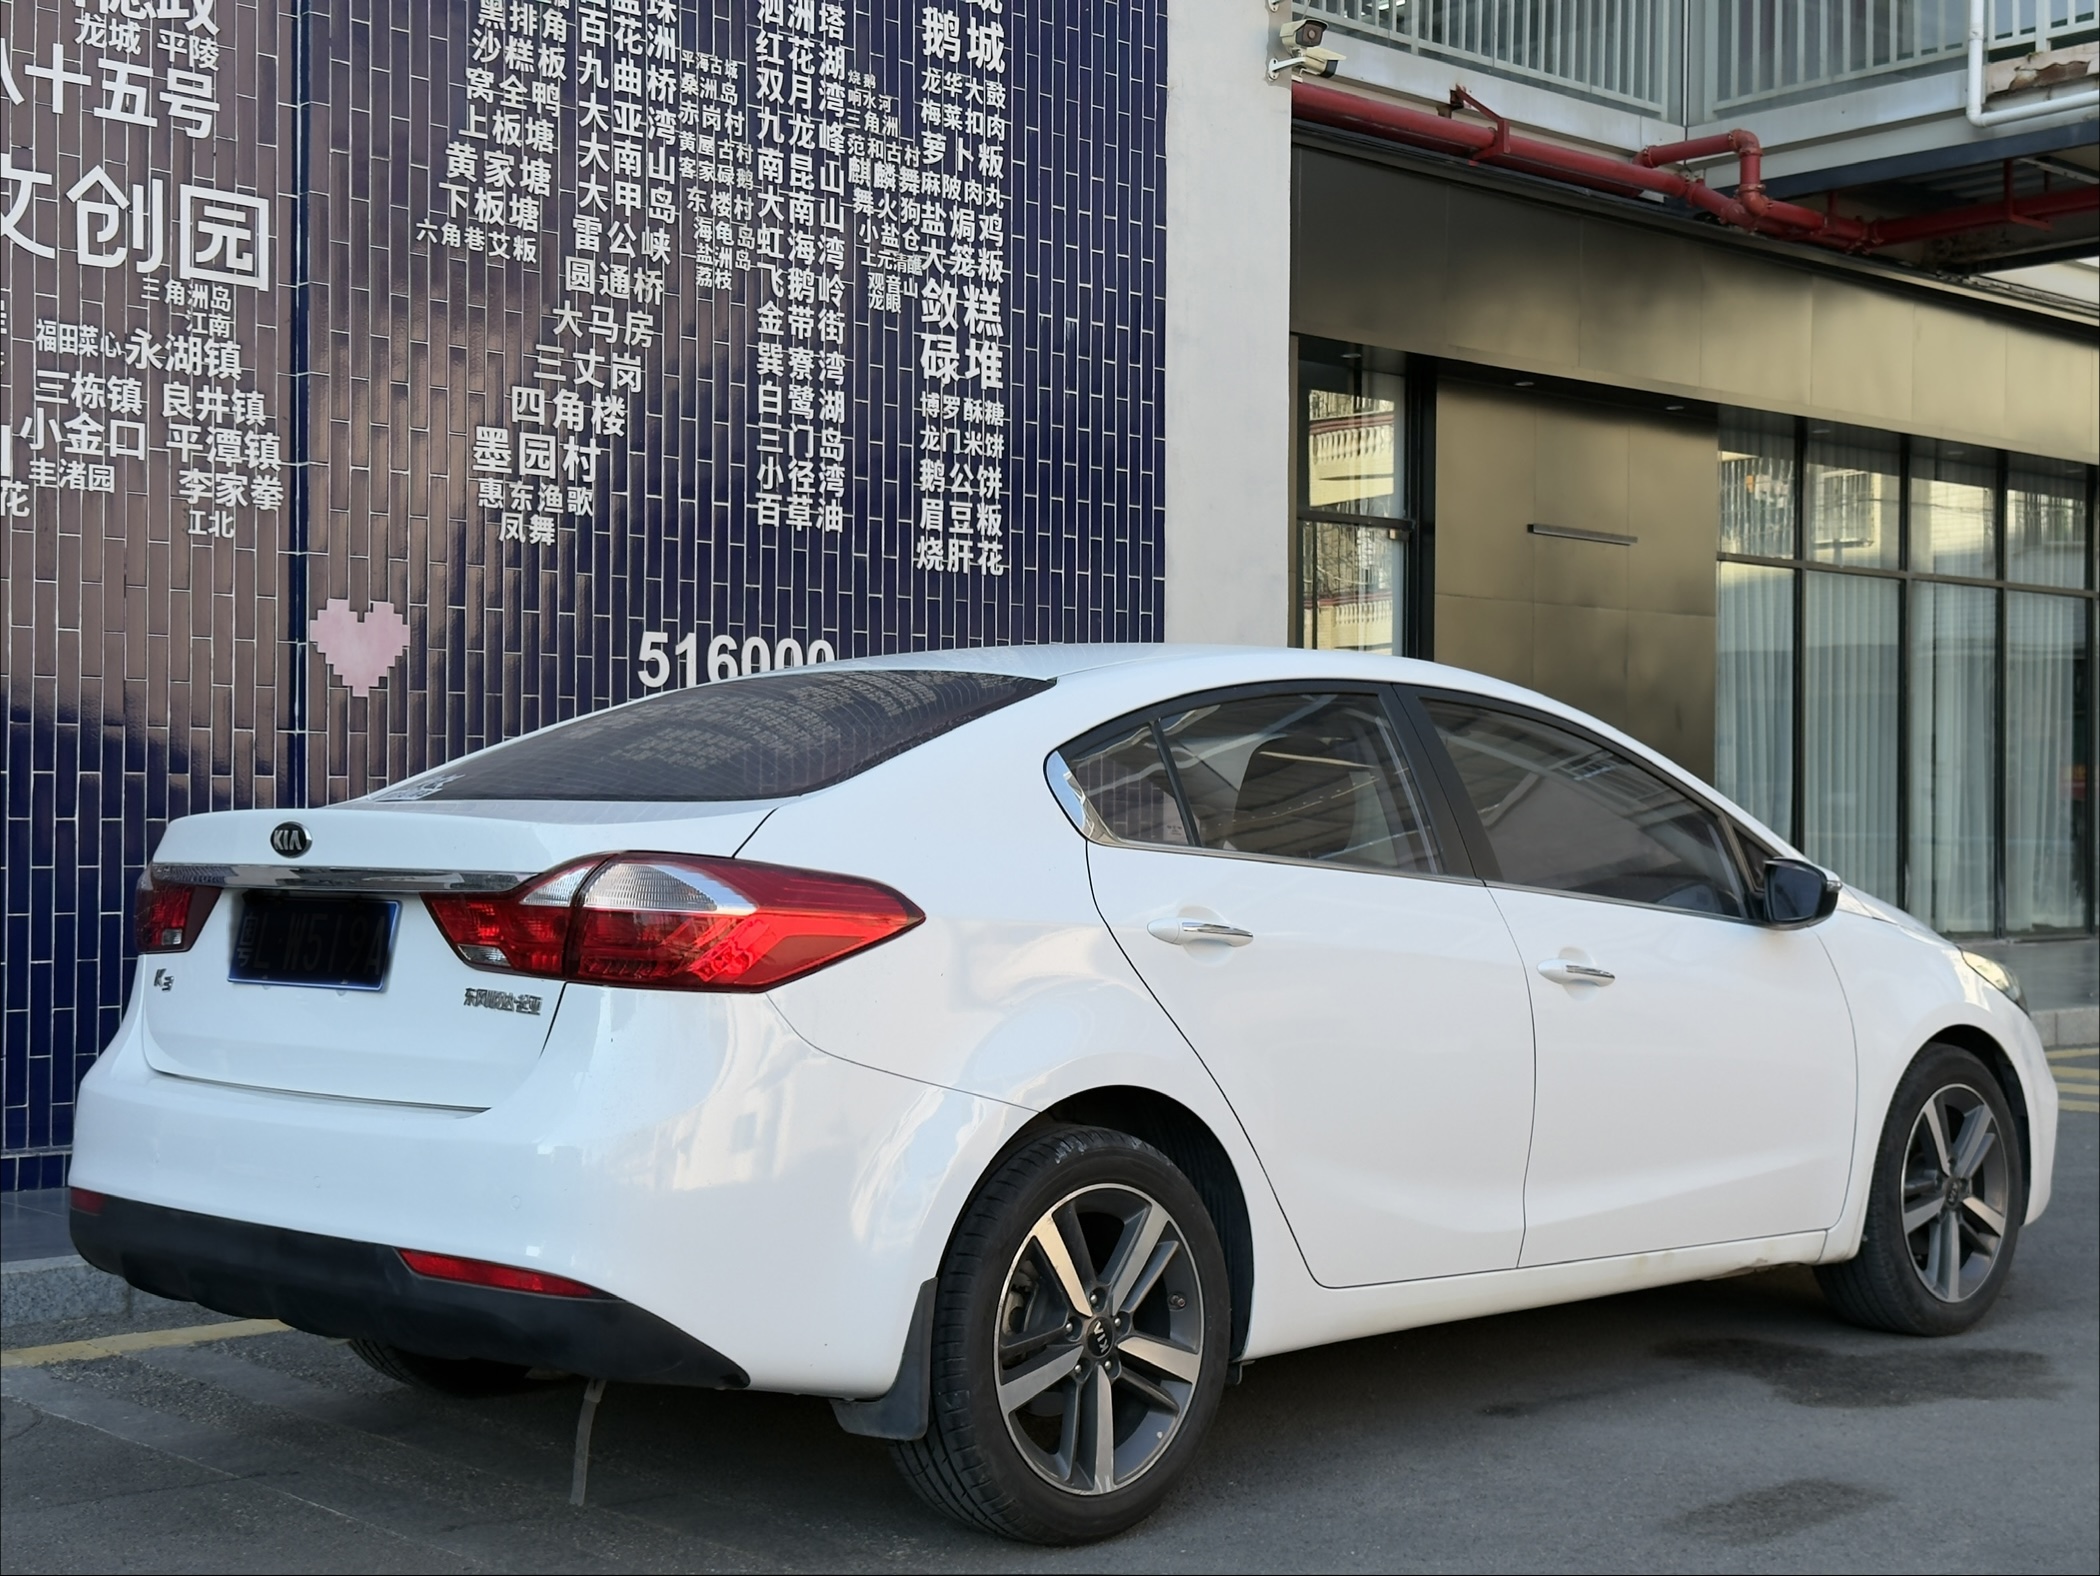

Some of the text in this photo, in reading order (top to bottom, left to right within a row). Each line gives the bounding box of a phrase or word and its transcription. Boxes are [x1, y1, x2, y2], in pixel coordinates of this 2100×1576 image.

[74, 12, 141, 55] 龙城
[157, 28, 220, 71] 平陵
[478, 0, 567, 43] 黑排角
[578, 7, 676, 63] 百花洲
[757, 0, 846, 41] 泗洲塔
[922, 6, 1006, 74] 鹅城
[471, 29, 567, 81] 沙糕板
[578, 49, 677, 104] 九曲桥
[681, 49, 738, 80] 平海古城
[755, 29, 846, 81] 红花湖
[466, 67, 560, 118] 窝全鸭
[681, 71, 738, 106] 桑洲岛
[756, 66, 846, 118] 双月湾
[848, 89, 892, 113] 响水河
[921, 67, 1006, 110] 龙华大鼓
[458, 104, 555, 154] 上板塘
[578, 92, 676, 146] 大亚湾
[677, 99, 745, 137] 赤岗村
[757, 106, 846, 156] 九龙峰
[845, 108, 898, 138] 三角洲
[921, 97, 1005, 141] 梅菜扣肉
[445, 141, 552, 197] 黄家塘
[578, 132, 676, 185] 大南山
[757, 147, 845, 197] 南昆山
[847, 133, 921, 168] 范和古村
[921, 131, 1004, 179] 萝卜粄
[848, 155, 920, 196] 麒麟舞
[921, 171, 1004, 210] 麻陂肉丸
[439, 182, 539, 233] 下板塘
[578, 173, 676, 225] 大甲岛
[686, 185, 754, 221] 东楼村
[757, 185, 845, 233] 大南山
[852, 187, 920, 226] 舞火狗
[416, 218, 537, 263] 六角巷艾粄
[572, 213, 672, 265] 雷公峡
[693, 216, 755, 250] 海龟岛
[859, 218, 921, 252] 小盐仓
[921, 200, 1004, 247] 盐焗鸡
[696, 242, 751, 271] 盐洲岛
[757, 222, 845, 271] 虹海湾
[141, 277, 232, 312] 三角洲岛
[565, 256, 664, 305] 圆通桥
[695, 266, 733, 291] 荔枝
[757, 261, 845, 308] 飞鹅岭
[867, 272, 918, 299] 观音山
[186, 310, 231, 338] 江南
[552, 300, 654, 348] 大马房
[757, 300, 845, 345] 金带街
[868, 290, 901, 314] 龙眼
[921, 277, 1004, 337] 敛糕
[36, 318, 125, 358] 福田菜心
[125, 328, 242, 381] 永湖镇
[533, 343, 642, 393] 三丈岗
[756, 341, 846, 385] 巽寮湾
[920, 333, 1004, 390] 碌堆
[34, 370, 143, 416] 三栋镇
[161, 381, 268, 427] 良井镇
[511, 385, 628, 438] 四角楼
[758, 380, 845, 424] 白鹭湖
[920, 391, 1005, 427] 博罗酥糖
[20, 407, 146, 460] 小金口
[166, 423, 282, 472] 平潭镇
[472, 425, 601, 483] 墨园村
[756, 422, 845, 462] 三门岛
[920, 425, 1005, 459] 龙门米饼
[28, 457, 115, 493] 丰渚园
[178, 468, 285, 511] 李家拳
[478, 477, 594, 517] 惠东渔歌
[756, 456, 845, 498] 小径湾
[920, 459, 1003, 500] 鹅公饼
[188, 510, 235, 538] 江北
[498, 512, 556, 546] 凤舞
[755, 492, 843, 533] 百草油
[920, 498, 1003, 537] 眉豆粄
[916, 536, 1005, 576] 烧肝花
[153, 968, 174, 991] K3
